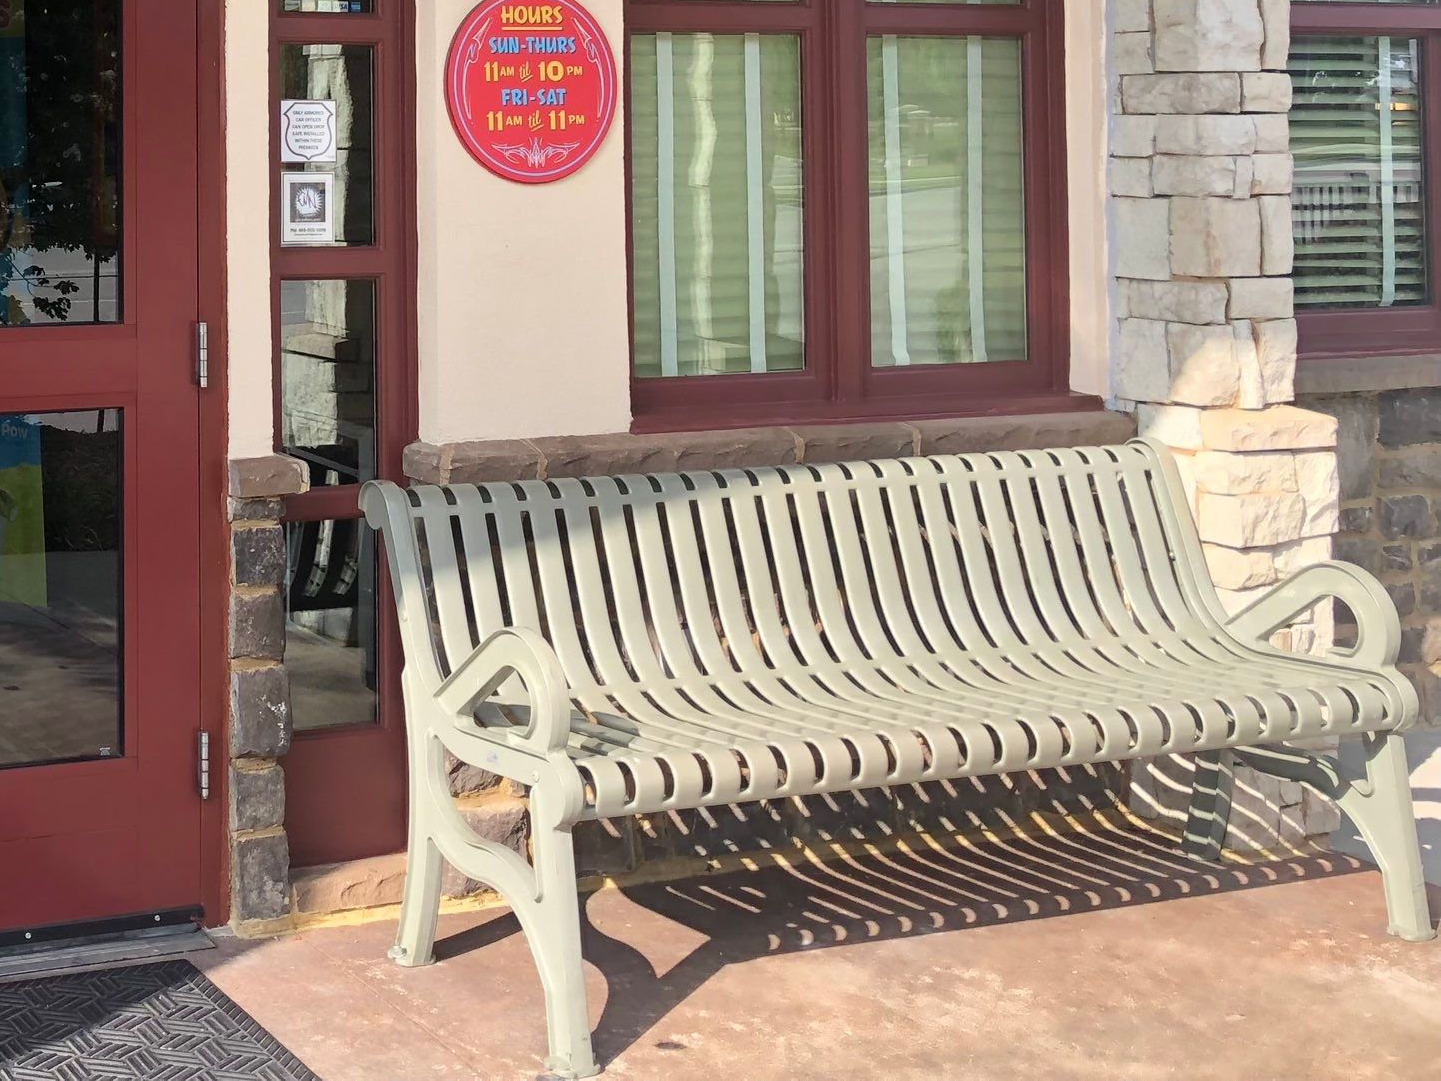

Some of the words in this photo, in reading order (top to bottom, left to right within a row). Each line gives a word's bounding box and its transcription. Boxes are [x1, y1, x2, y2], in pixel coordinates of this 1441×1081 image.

[500, 5, 563, 24] HOURS
[489, 36, 577, 55] SUN-THURS
[538, 60, 564, 82] 10
[567, 65, 583, 76] PM
[501, 88, 567, 106] FRI-SAT
[548, 110, 566, 130] 11
[568, 114, 585, 125] PM
